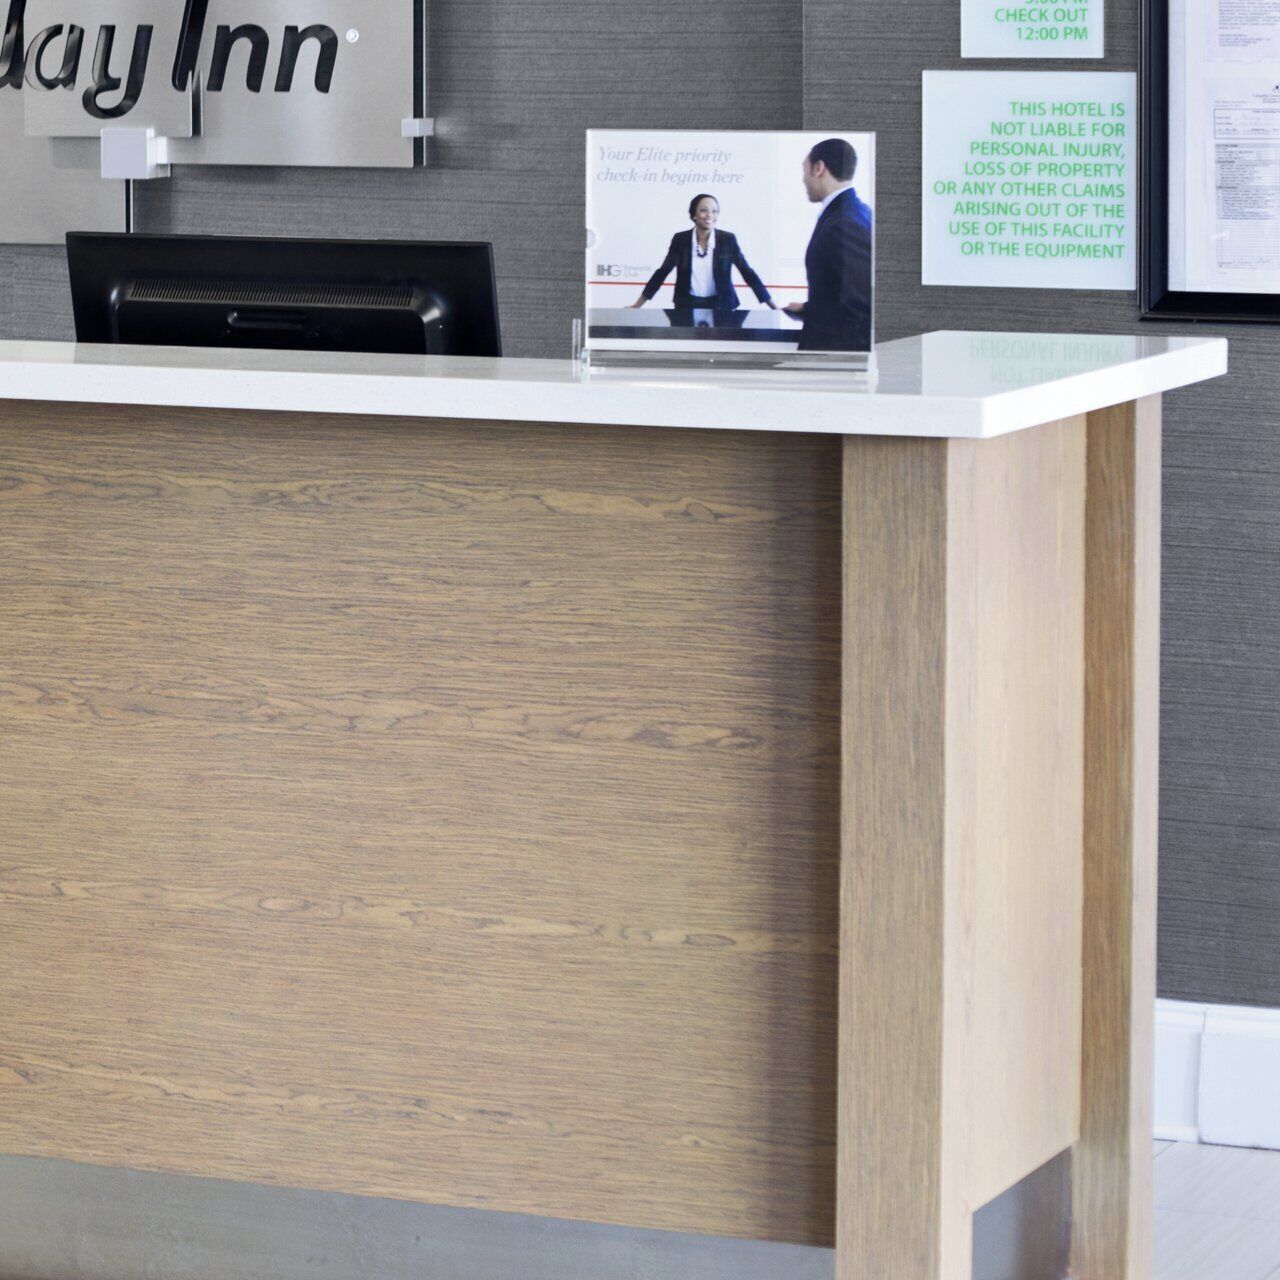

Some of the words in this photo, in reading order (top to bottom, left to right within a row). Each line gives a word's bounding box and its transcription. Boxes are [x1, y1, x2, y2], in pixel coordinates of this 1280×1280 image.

[995, 8, 1049, 22] CHECK
[1053, 8, 1088, 22] OUT
[1016, 26, 1059, 40] 12:00
[1063, 26, 1088, 40] PM
[1009, 101, 1047, 117] THIS
[1052, 102, 1106, 117] HOTEL
[1111, 102, 1125, 118] IS
[991, 121, 1026, 136] NOT
[1030, 122, 1086, 137] LIABLE
[1092, 122, 1125, 137] FOR
[599, 146, 634, 162] Your
[636, 146, 672, 162] Elite
[674, 148, 732, 165] priority
[970, 141, 1058, 156] PERSONAL
[1063, 142, 1125, 160] INJURY,
[596, 168, 658, 183] check-in
[661, 169, 709, 185] begins
[711, 170, 745, 184] here
[964, 162, 1005, 176] LOSS
[1010, 162, 1033, 176] OF
[1037, 162, 1125, 177] PROPERTY
[933, 181, 957, 195] OR
[962, 181, 996, 196] ANY
[1001, 182, 1057, 197] OTHER
[1062, 183, 1125, 198] CLAIMS
[953, 201, 1021, 216] ARISING
[1025, 202, 1061, 217] OUT
[1066, 203, 1088, 217] OF
[1093, 203, 1125, 218] THE
[949, 221, 980, 236] USE
[985, 222, 1006, 236] OF
[1011, 222, 1048, 237] THIS
[1053, 223, 1125, 238] FACILITY
[961, 241, 984, 256] OR
[988, 242, 1020, 256] THE
[1025, 243, 1125, 259] EQUIPMENT
[596, 264, 622, 277] IHG
